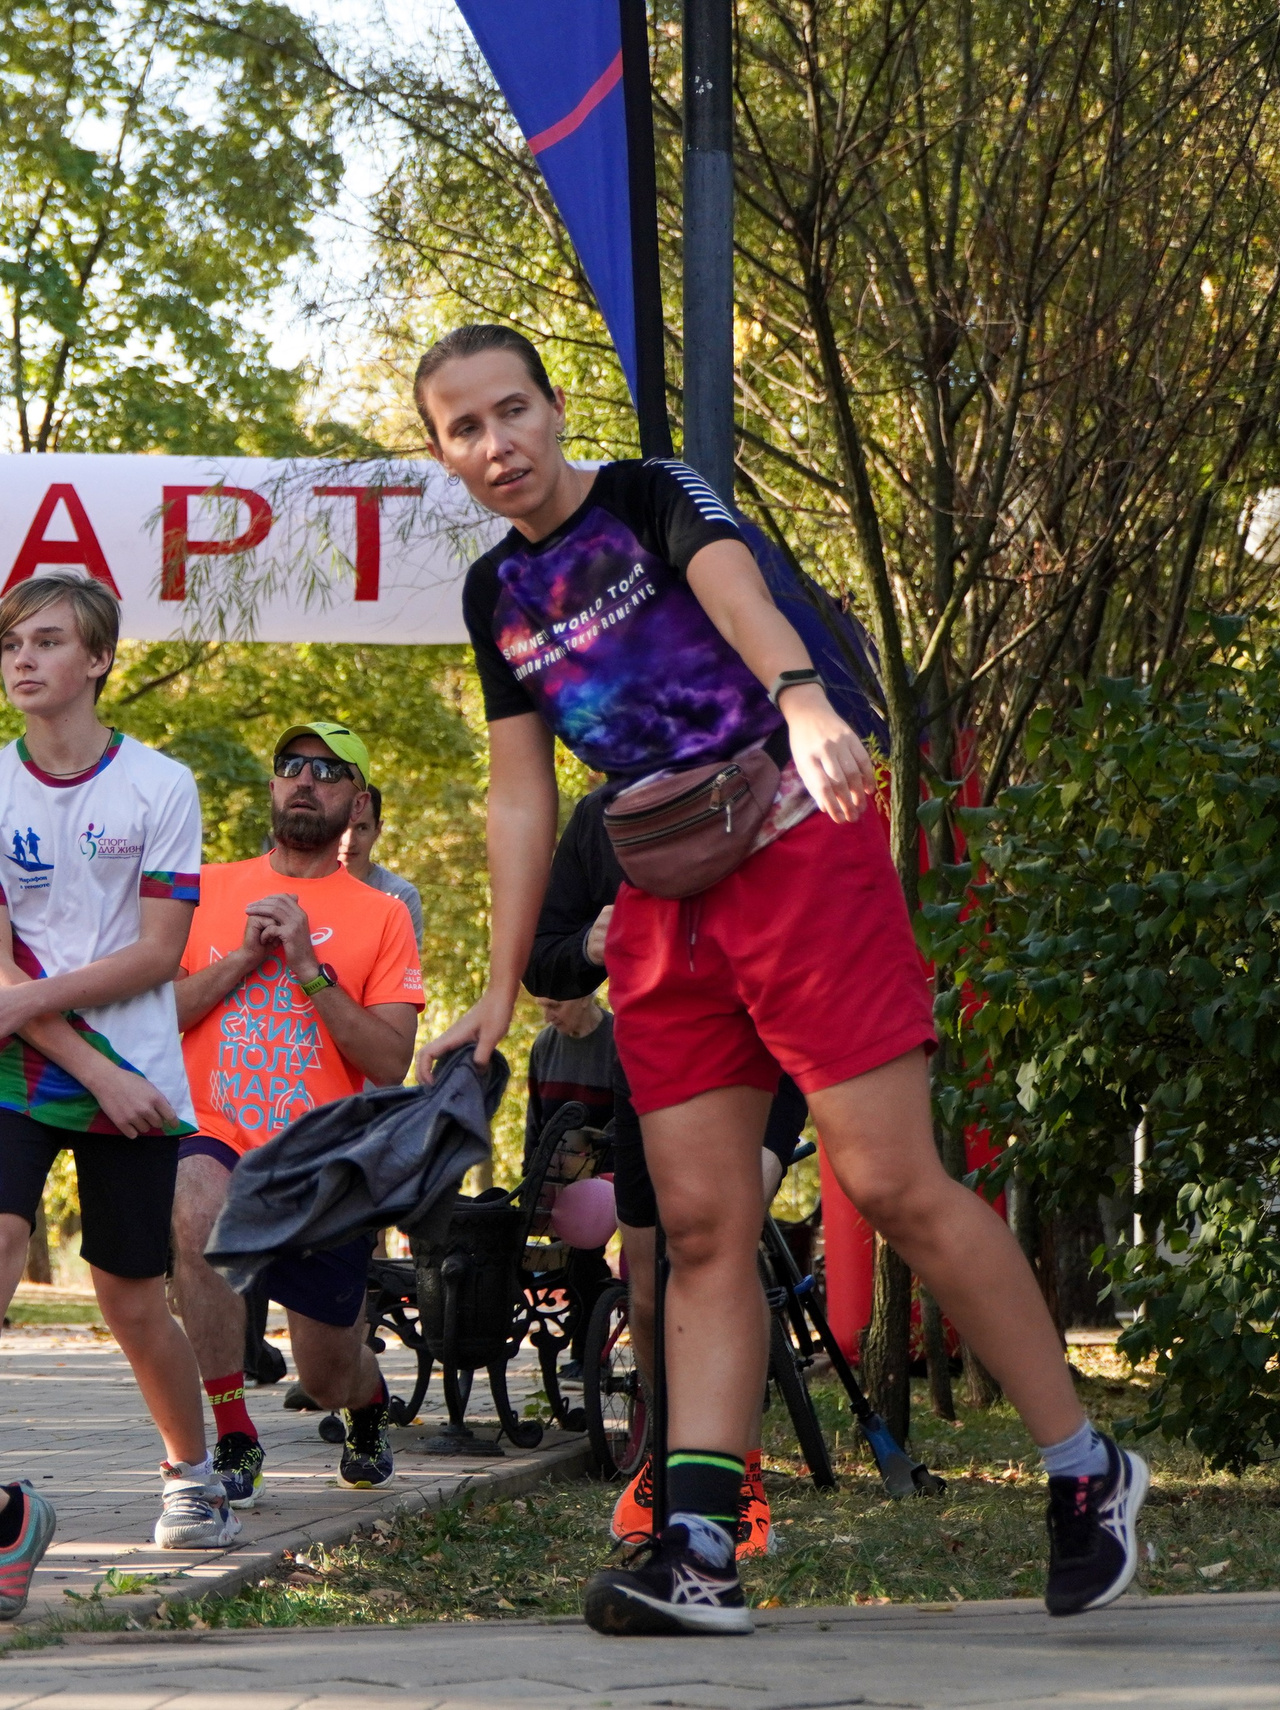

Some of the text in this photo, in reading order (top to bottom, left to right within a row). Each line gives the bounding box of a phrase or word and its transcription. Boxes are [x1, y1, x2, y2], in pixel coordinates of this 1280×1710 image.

[552, 597, 603, 635] WORLD
[606, 562, 645, 599] TOUR
[97, 846, 116, 854] ДЛЯ
[98, 838, 128, 847] СПОРТ
[219, 1041, 314, 1075] ПОЛУ
[220, 1072, 310, 1106] МАРА
[222, 1102, 291, 1132] ФОН
